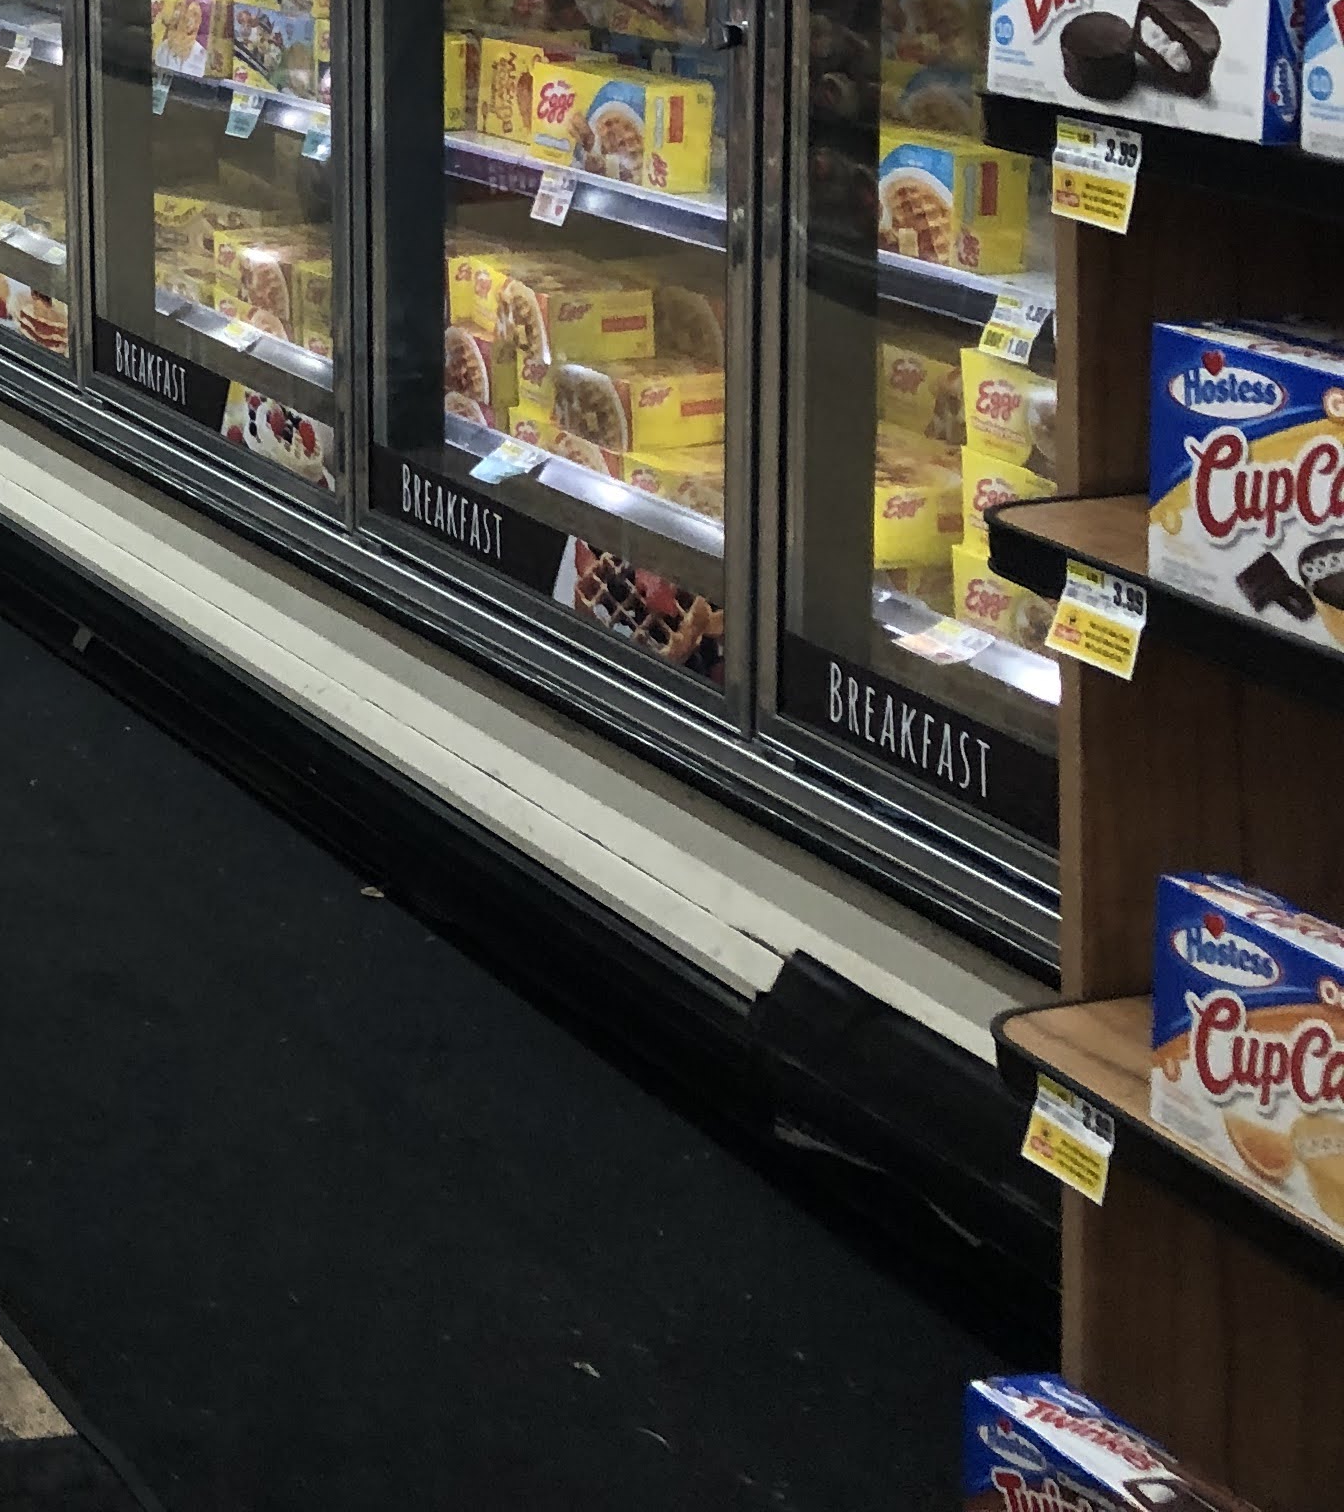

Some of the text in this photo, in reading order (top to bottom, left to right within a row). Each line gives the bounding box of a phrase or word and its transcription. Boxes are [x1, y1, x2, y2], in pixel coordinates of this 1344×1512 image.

[537, 81, 576, 124] Eggo
[1103, 138, 1139, 169] 3.99
[114, 328, 188, 406] BREAKFAST
[1184, 368, 1279, 406] Hostess
[976, 379, 1023, 422] Eggo
[401, 461, 504, 561] BREAKFAST
[1189, 434, 1344, 539] CupCa
[827, 662, 992, 801] BREAKFAST
[1185, 924, 1274, 978] Hostess
[1190, 996, 1344, 1108] CupCa
